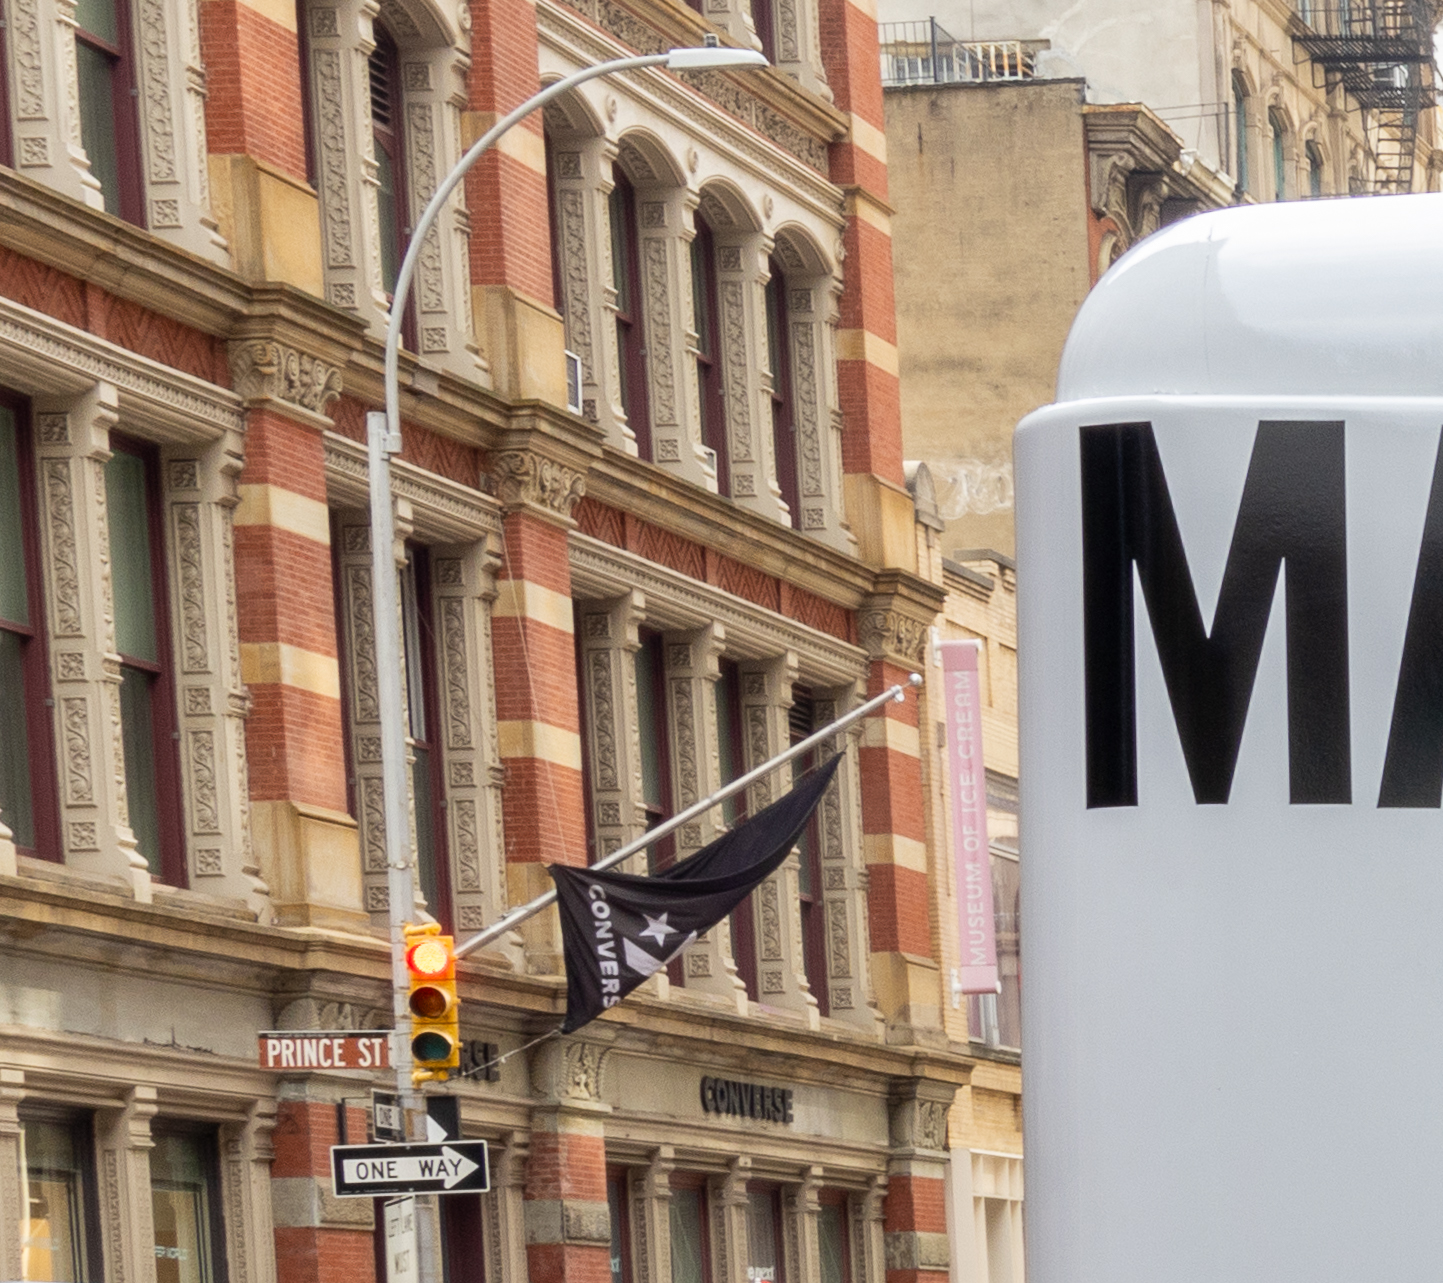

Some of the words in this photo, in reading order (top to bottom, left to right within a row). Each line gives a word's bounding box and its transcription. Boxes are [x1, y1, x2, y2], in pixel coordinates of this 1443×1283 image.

[955, 669, 975, 760] CREAM
[959, 773, 977, 814] ICE
[963, 825, 980, 851] OF
[965, 863, 987, 967] MUSEUM
[267, 1038, 346, 1067] PRINCE
[358, 1037, 383, 1067] ST
[701, 1075, 794, 1124] CONVERSE
[356, 1161, 398, 1180] ONE
[419, 1158, 462, 1177] WAY
